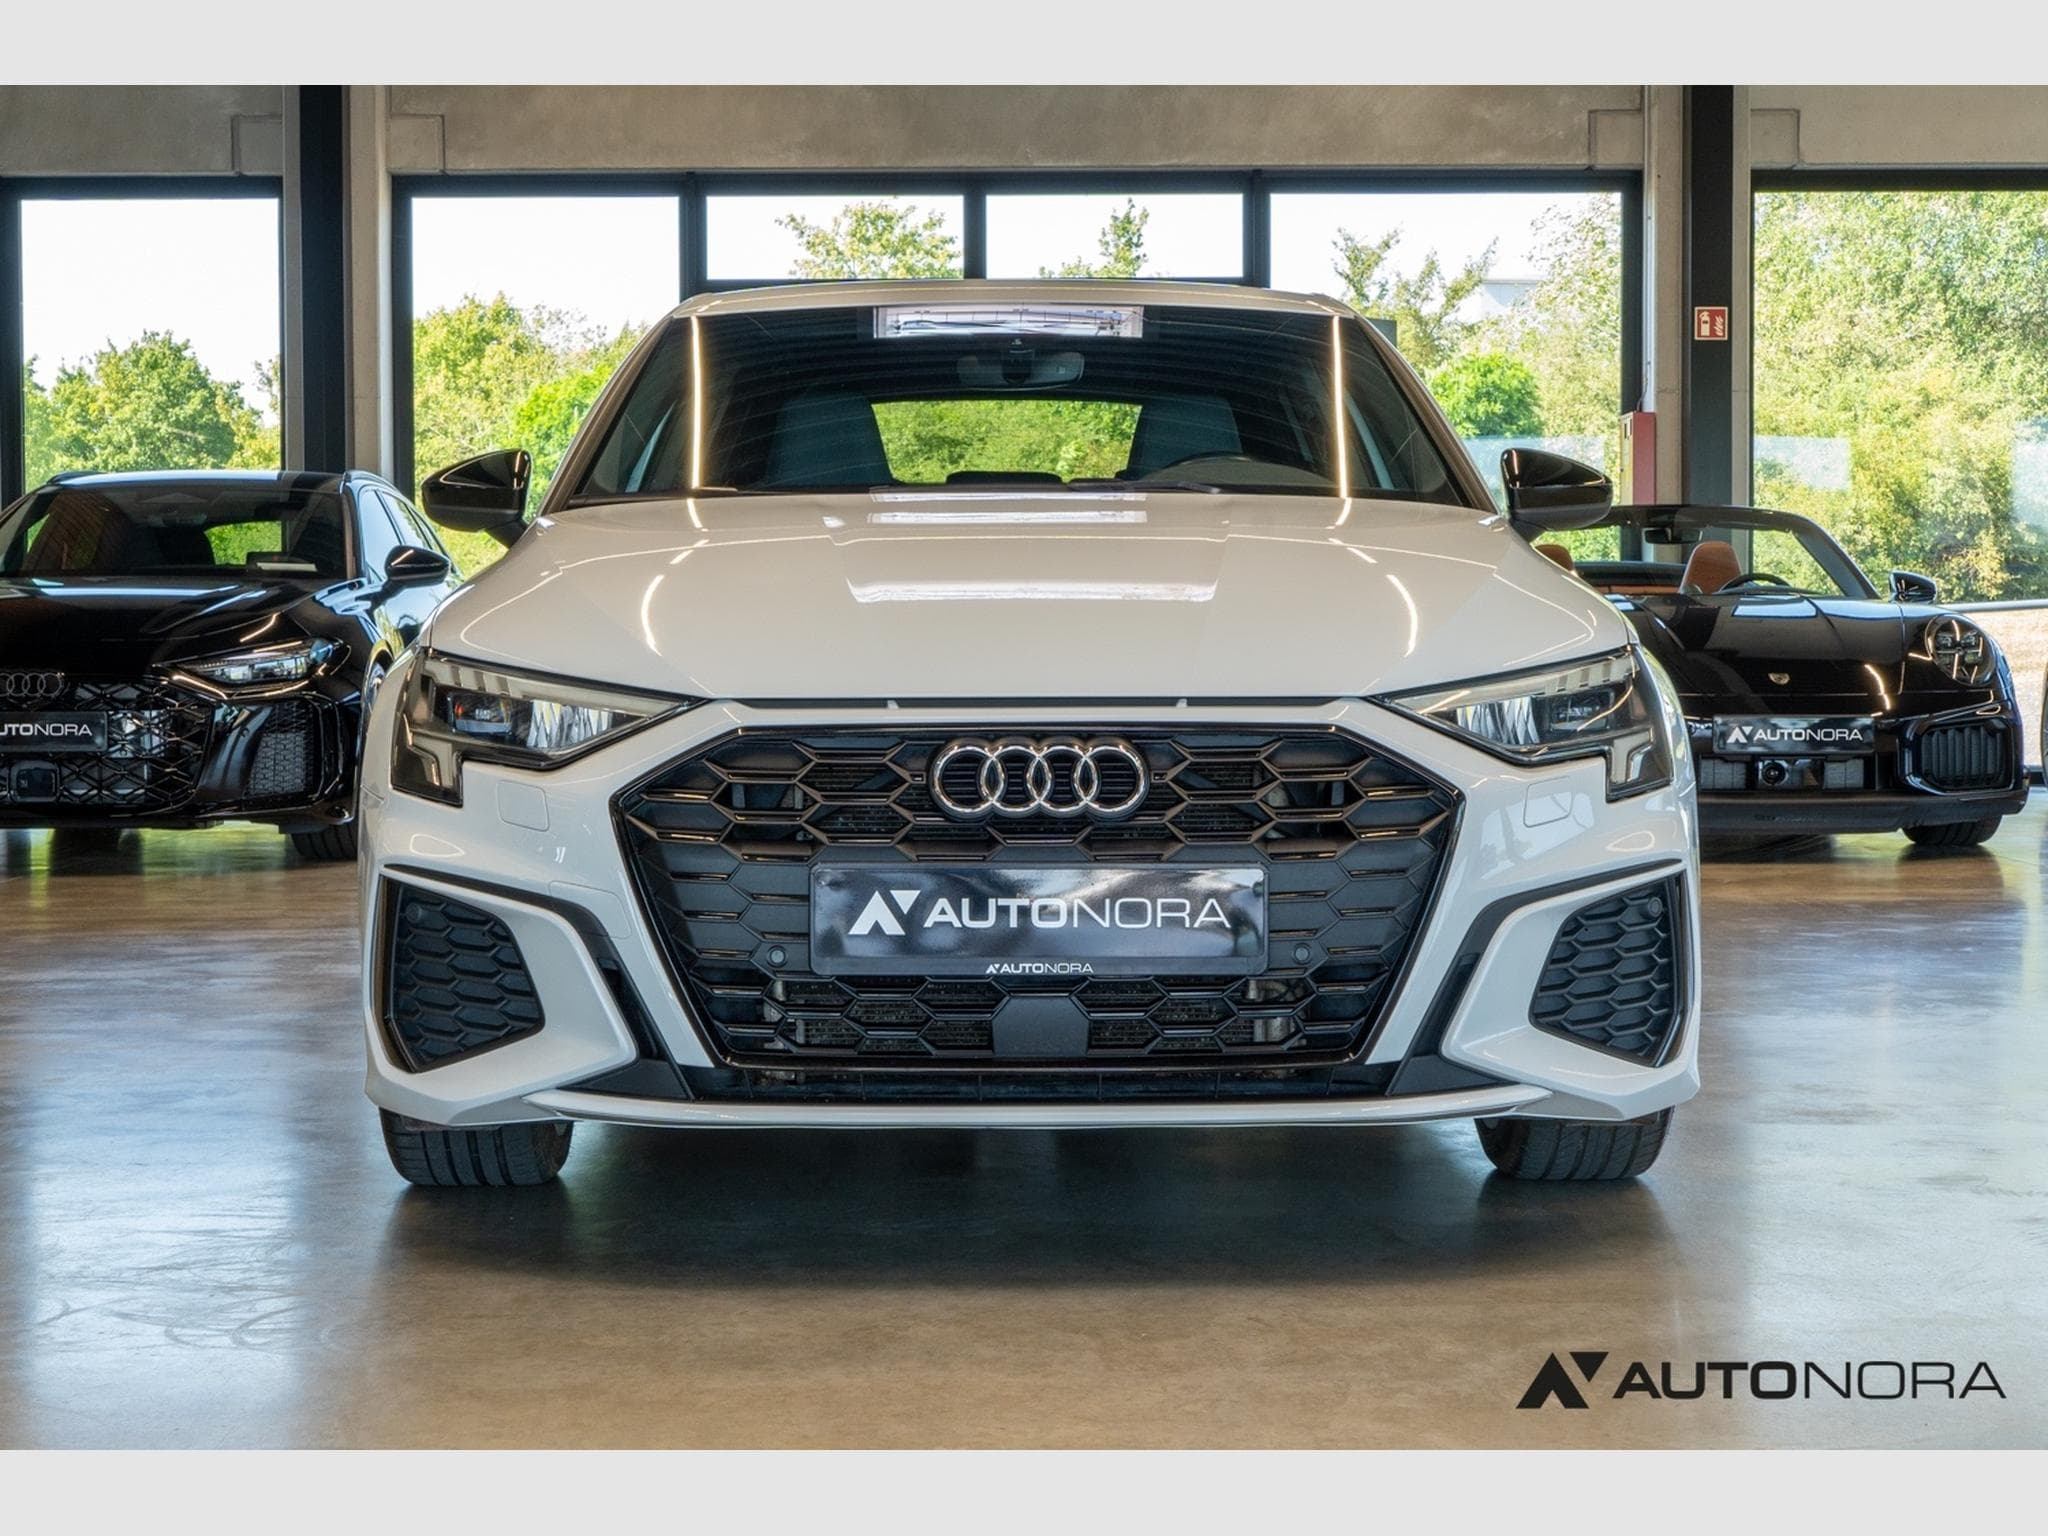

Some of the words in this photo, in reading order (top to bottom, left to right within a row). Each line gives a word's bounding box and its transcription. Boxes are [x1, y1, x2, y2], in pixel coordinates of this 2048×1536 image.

[1753, 728, 1863, 741] AUTONORA
[923, 897, 1231, 929] AUTONORA
[1000, 963, 1094, 974] AUTONORA
